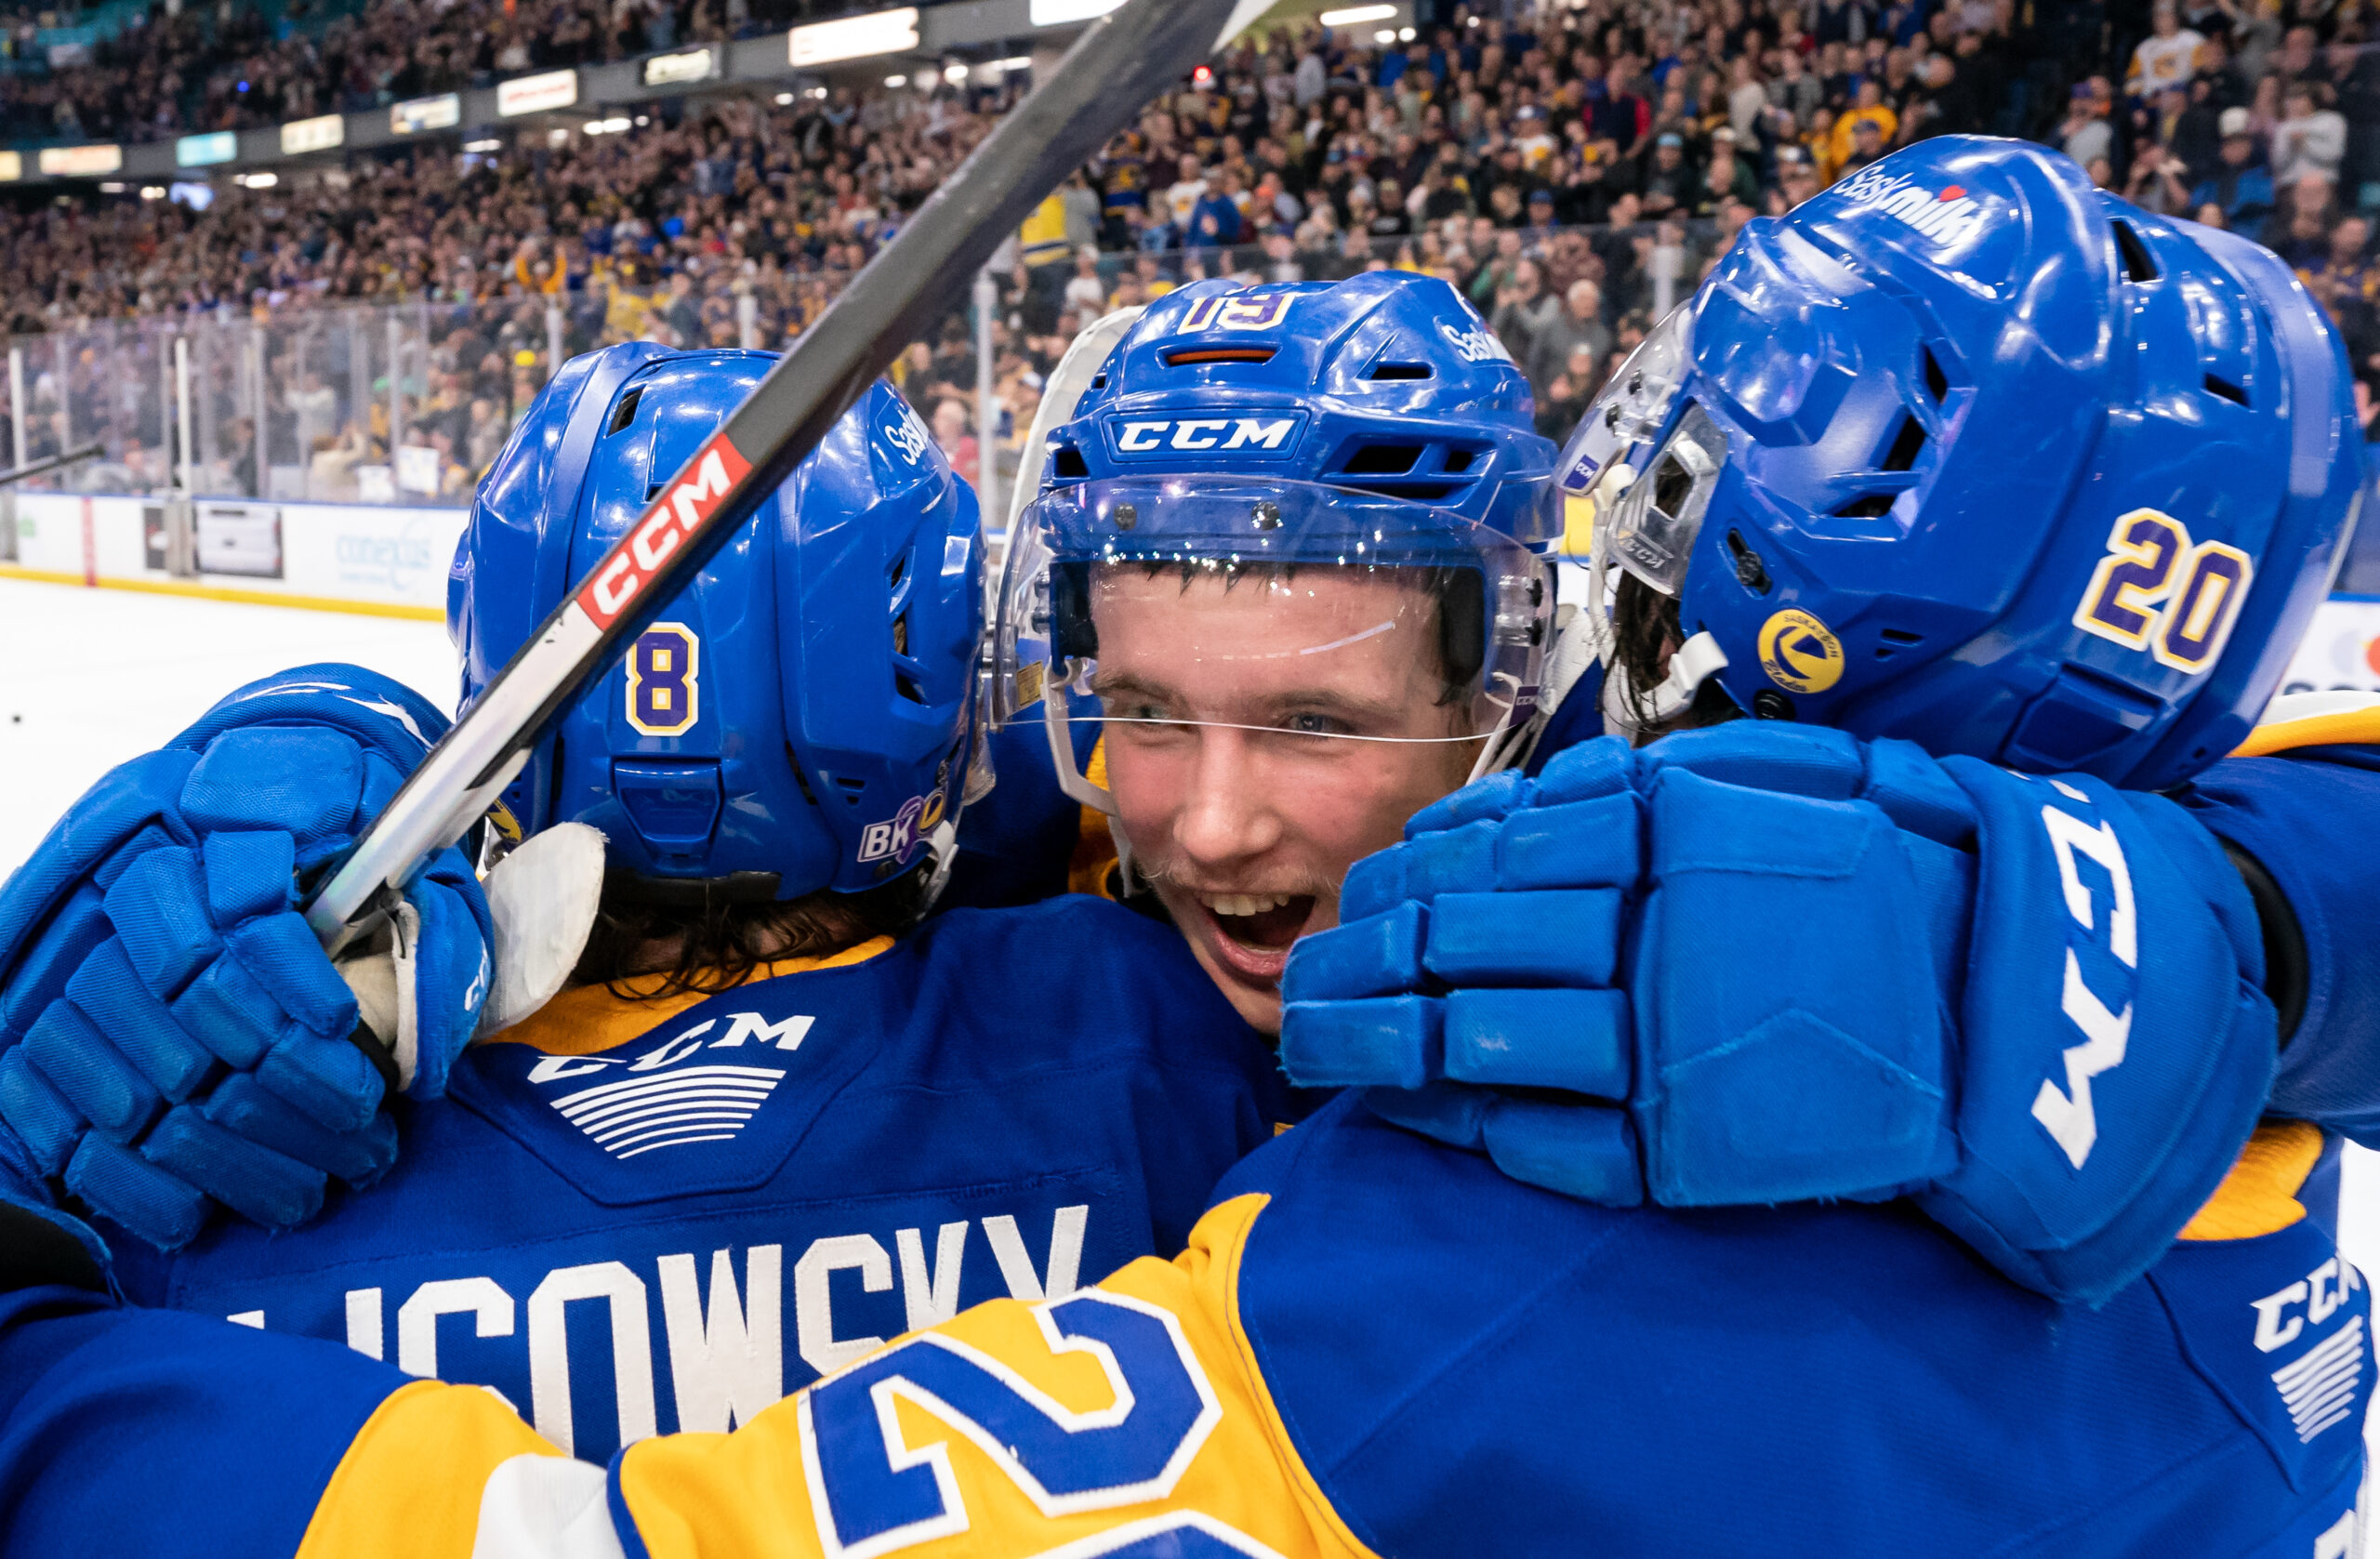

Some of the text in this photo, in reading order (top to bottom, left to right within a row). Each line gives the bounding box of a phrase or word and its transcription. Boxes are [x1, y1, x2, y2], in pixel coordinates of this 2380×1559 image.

[1176, 292, 1297, 336] 19
[1117, 419, 1296, 452] CCM
[1575, 461, 1596, 480] CCM
[592, 448, 732, 615] CCM
[2071, 507, 2254, 676] 20
[625, 621, 700, 737] 8
[2030, 779, 2137, 1170] CM
[526, 1011, 816, 1085] CCM
[797, 1287, 1288, 1559] 2
